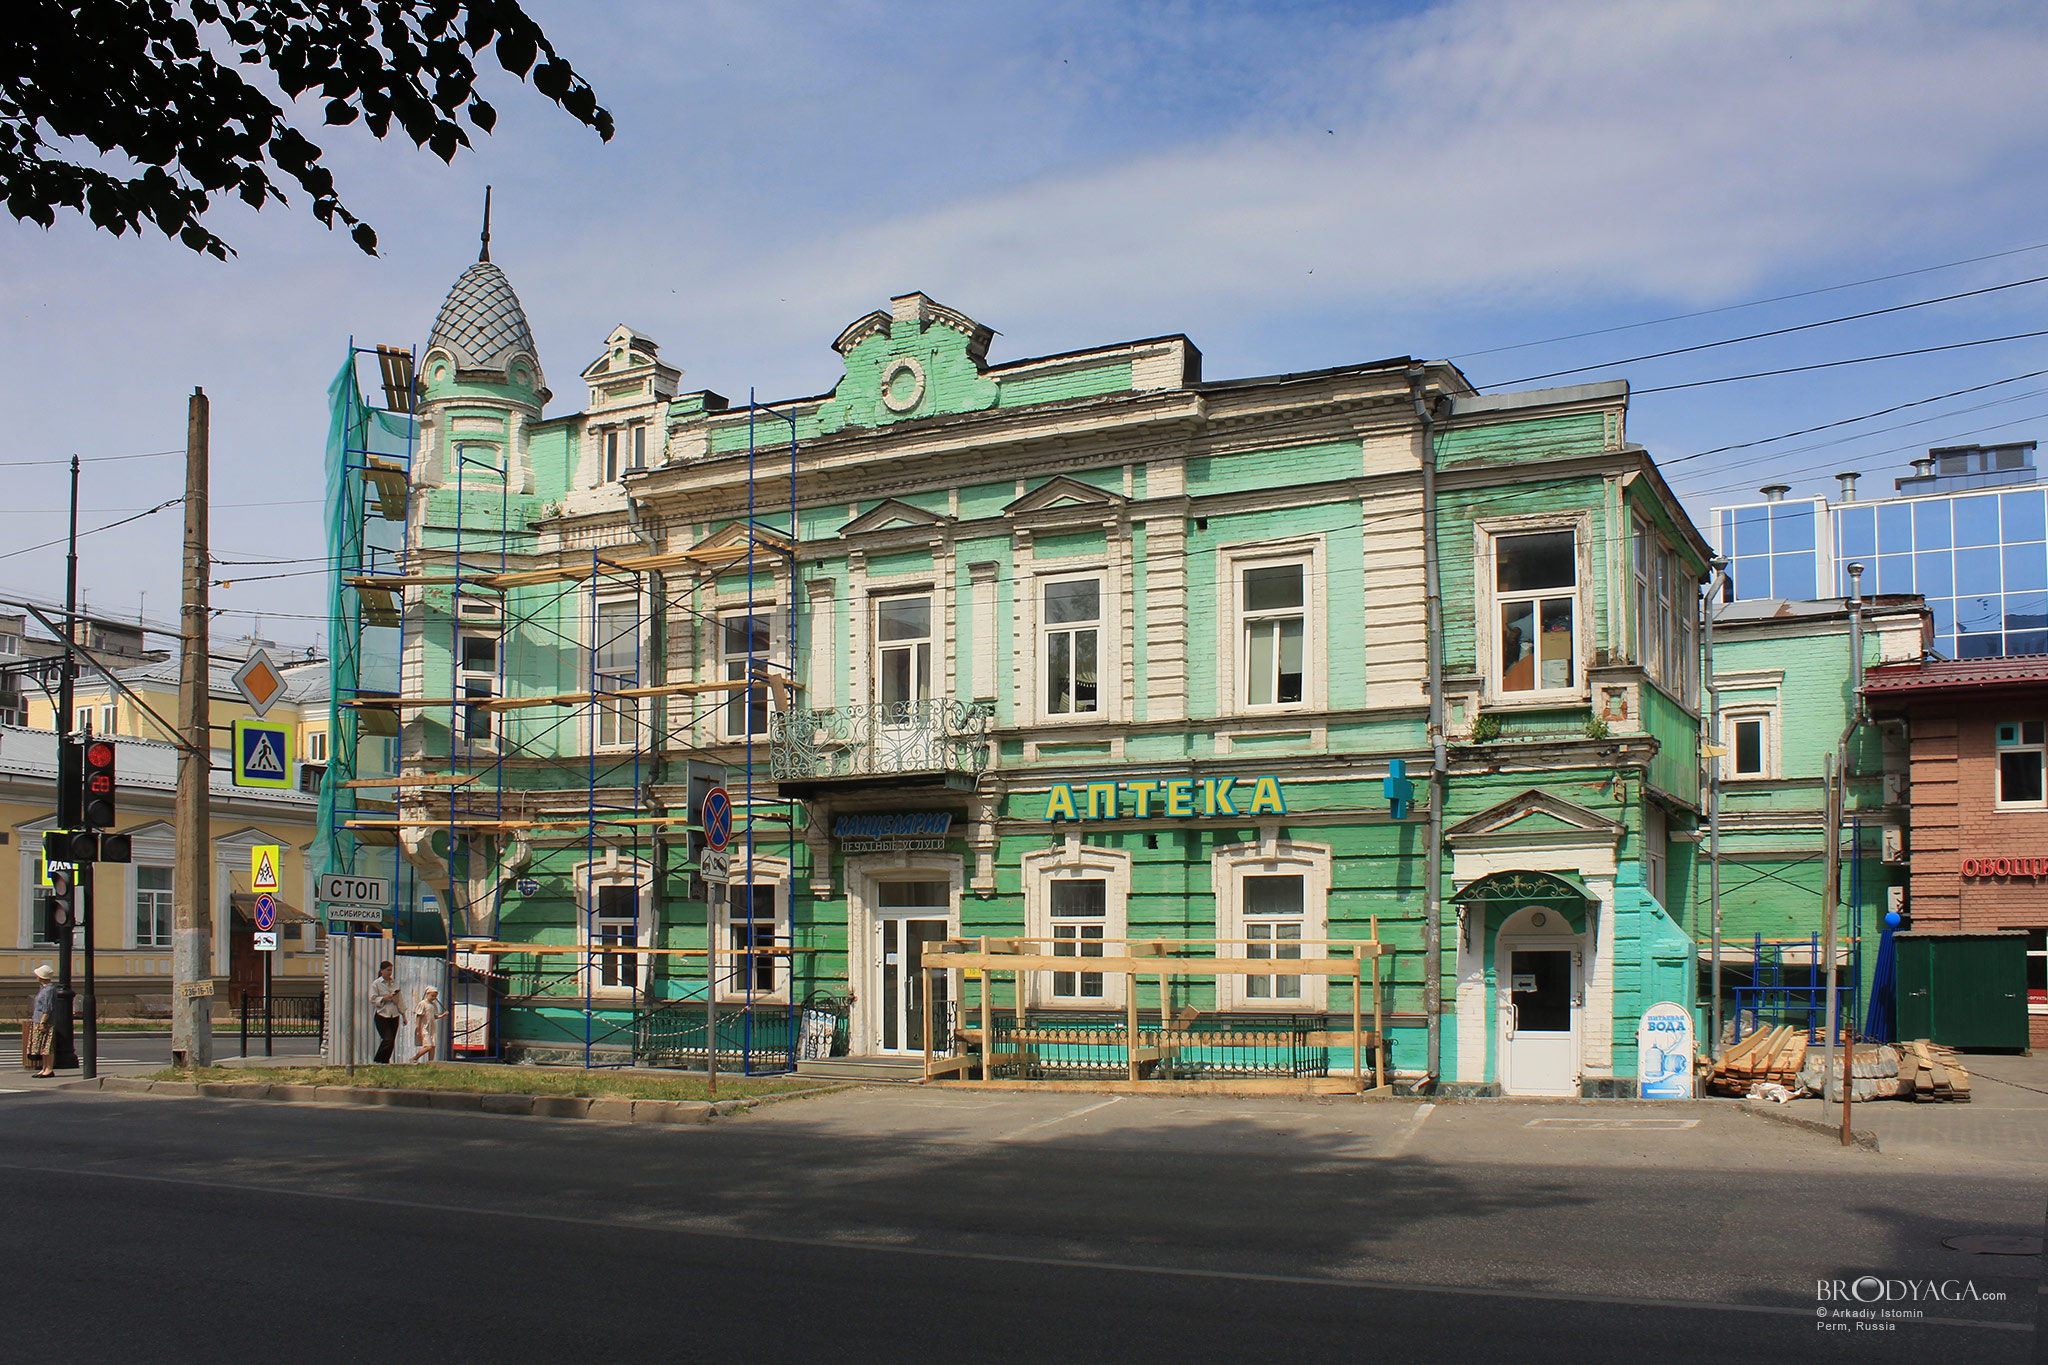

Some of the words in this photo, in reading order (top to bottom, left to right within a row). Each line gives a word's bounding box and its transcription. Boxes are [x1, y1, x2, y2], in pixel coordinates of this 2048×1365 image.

[1043, 775, 1287, 820] АПТЕКА
[833, 812, 952, 840] КАНЦЕЛЯРИЯ
[841, 841, 897, 852] ПЕЧАТНЫЕ
[902, 839, 945, 850] УСЛУГИ
[331, 880, 379, 900] СТОП
[1648, 1021, 1686, 1032] ВОДА
